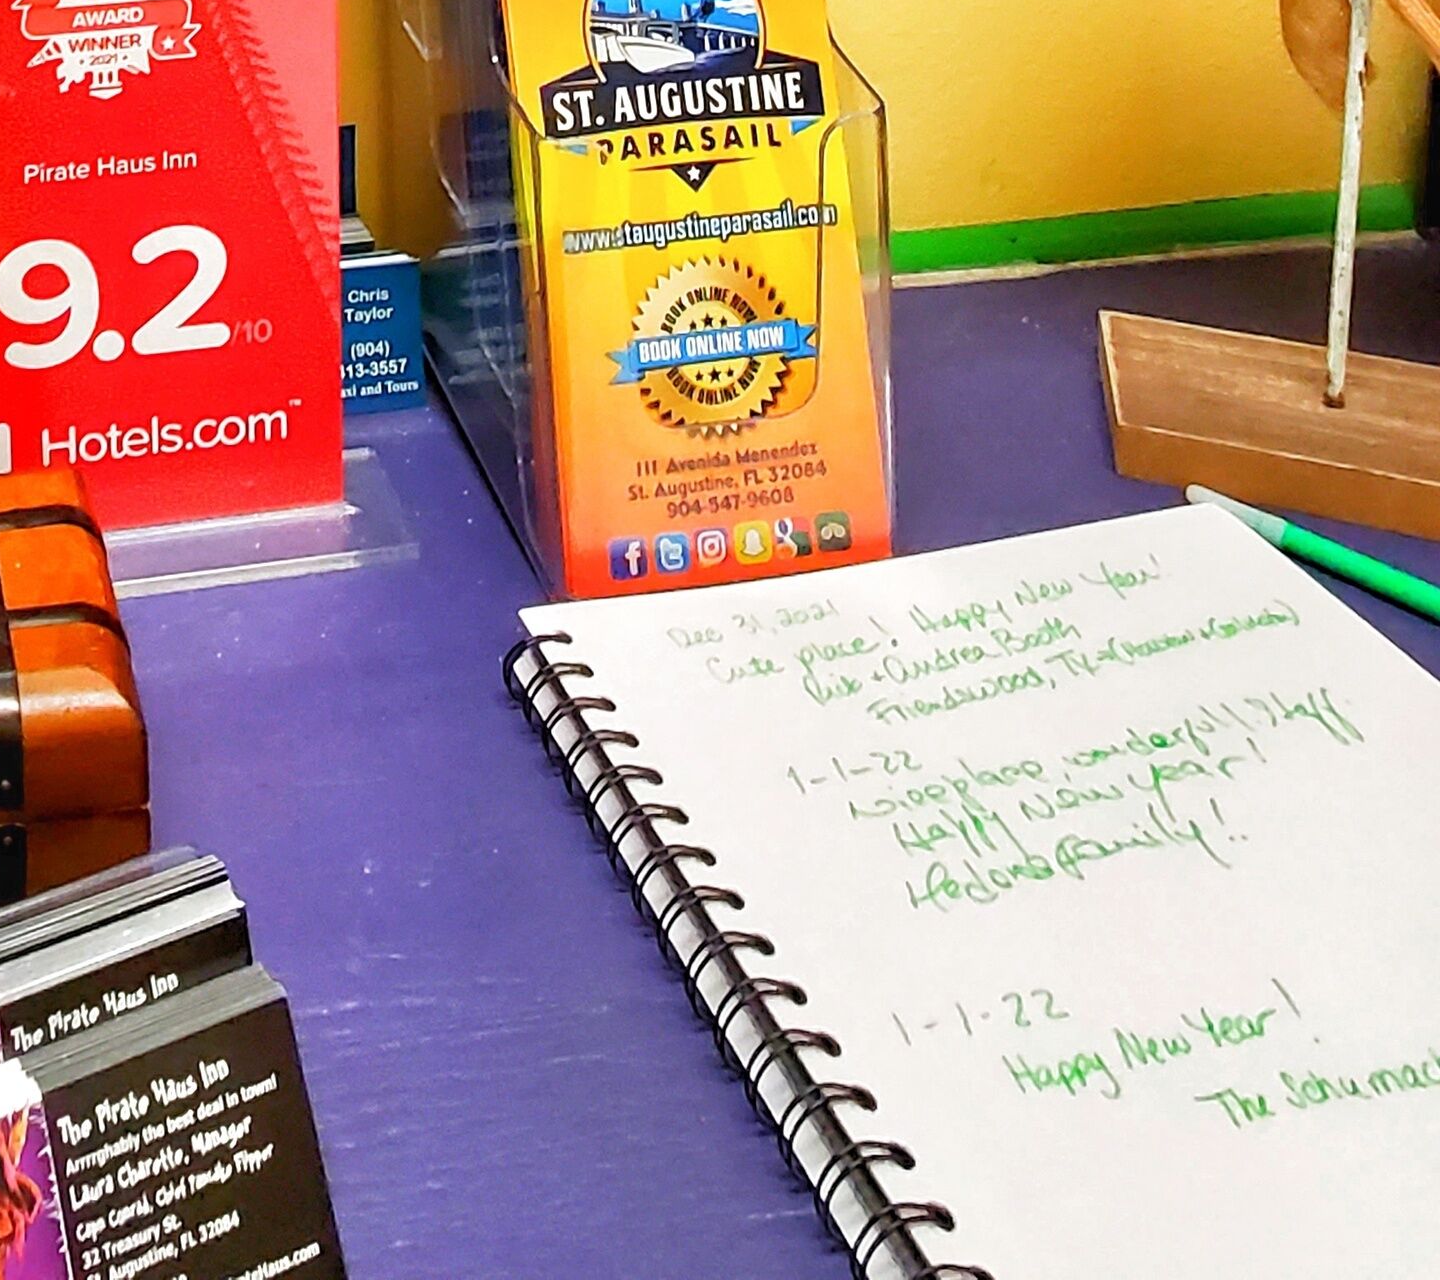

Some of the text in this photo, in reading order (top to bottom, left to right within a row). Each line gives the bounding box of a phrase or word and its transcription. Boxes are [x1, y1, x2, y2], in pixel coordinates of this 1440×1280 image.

[71, 6, 145, 29] AWARD
[67, 32, 143, 53] WINNER
[89, 53, 120, 67] 2021
[552, 71, 805, 131] ST. AUGUSTINE
[596, 122, 782, 167] PARASAIL
[22, 150, 198, 185] Pirate Haus Inn
[344, 306, 394, 324] Taylor
[347, 287, 390, 304] Chris
[660, 296, 687, 335] BOOK
[685, 286, 730, 306] ONLINE
[350, 339, 391, 362] (904)
[638, 325, 785, 364] BOOK ONLINE NOW
[359, 380, 383, 397] and
[384, 379, 420, 395] Tours
[40, 406, 289, 469] Hotels.com
[665, 451, 731, 474] Avenida
[735, 440, 818, 465] Menendez
[627, 459, 828, 502] St. Augustine, FL 32084
[1014, 579, 1073, 607] New
[786, 749, 924, 795] 1-1-22
[10, 971, 180, 1053] The Pirate Haus Inn
[1001, 1052, 1122, 1100] Happy
[1118, 1027, 1191, 1071] New
[56, 1058, 231, 1147] The Pirate Haus Inn
[140, 1122, 165, 1146] the
[165, 1108, 196, 1134] best
[196, 1091, 225, 1122] deal
[224, 1091, 240, 1109] in
[1194, 1084, 1277, 1130] The
[68, 1173, 115, 1213] Laura
[190, 1115, 253, 1157] Manager
[81, 1249, 102, 1271] 32
[101, 1222, 161, 1263] Treasury
[179, 1229, 198, 1252] FL
[197, 1209, 241, 1244] 32084
